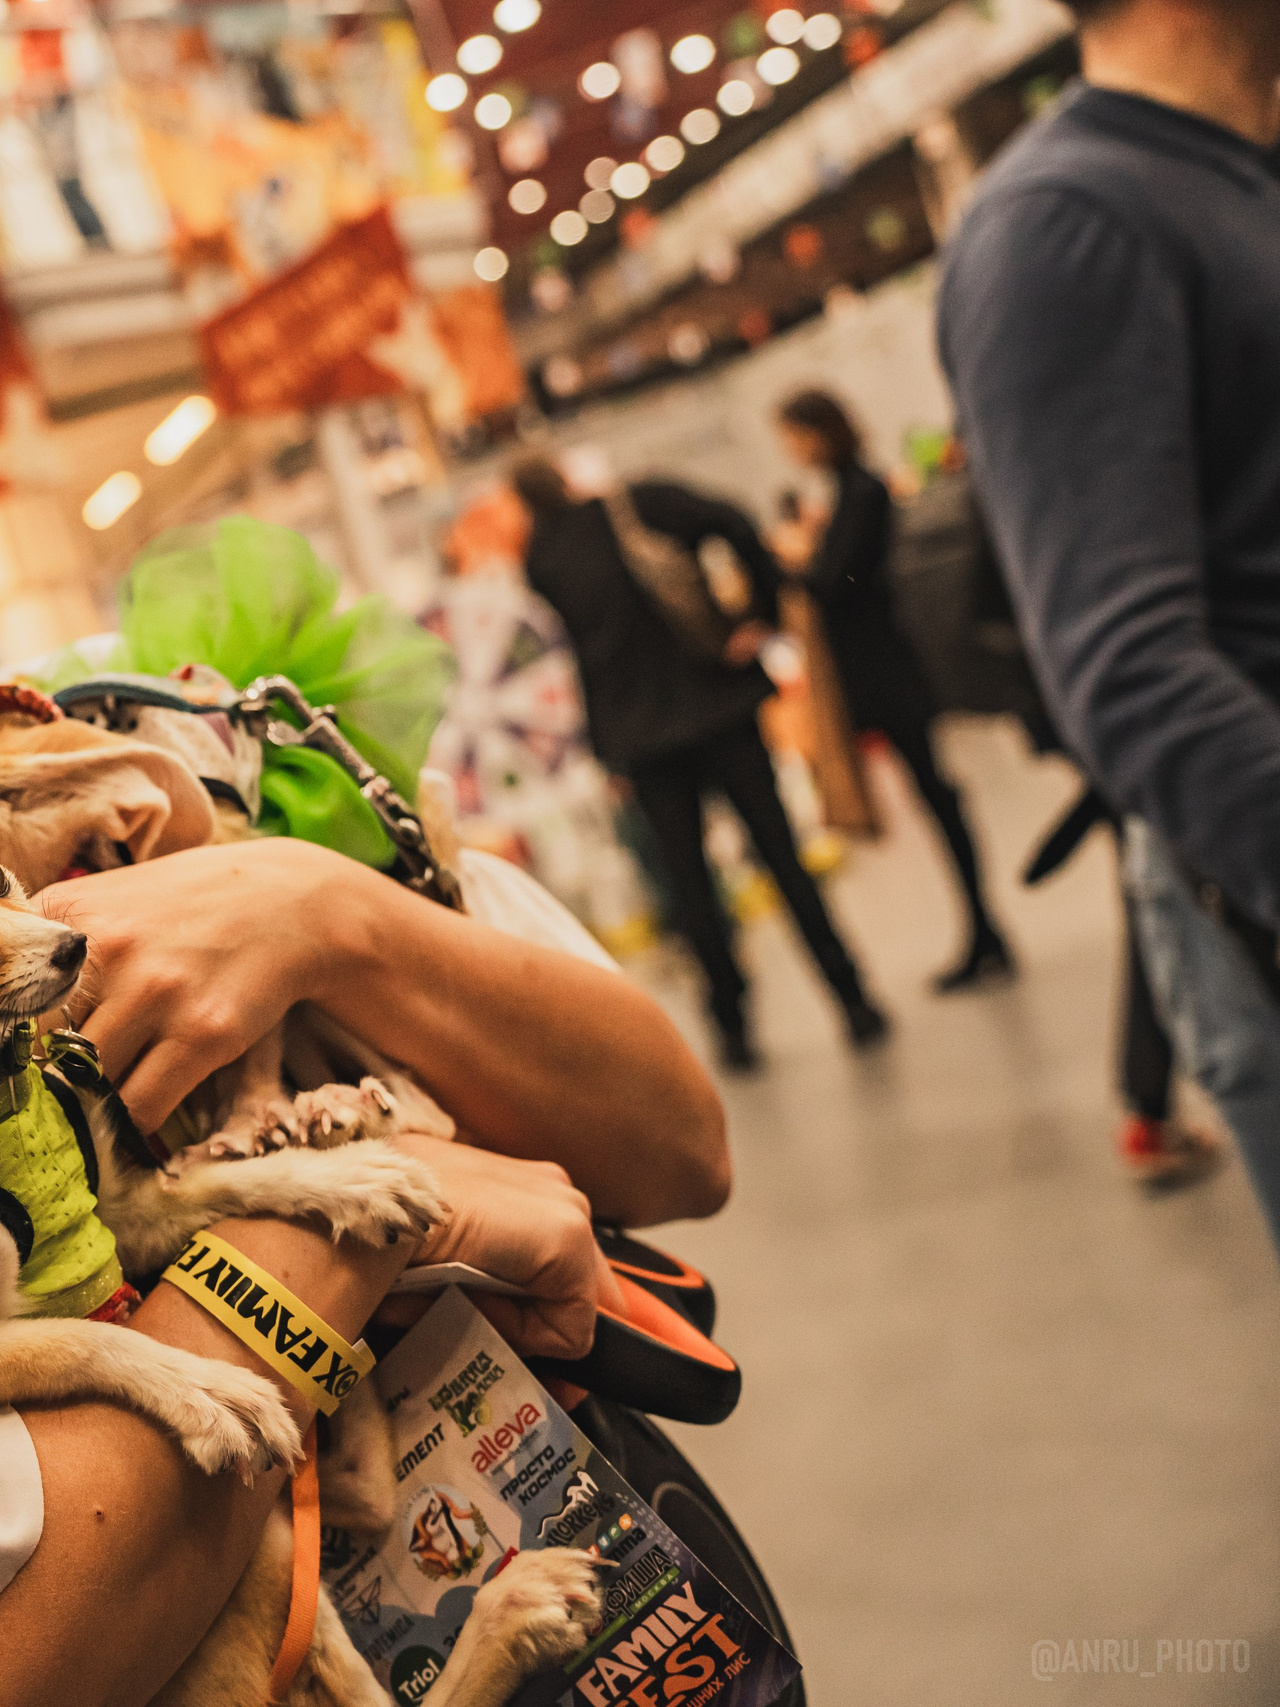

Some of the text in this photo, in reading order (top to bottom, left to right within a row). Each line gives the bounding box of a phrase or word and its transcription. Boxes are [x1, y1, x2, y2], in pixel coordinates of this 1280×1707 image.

[192, 1256, 329, 1373] FAMILY
[312, 1351, 359, 1398] OX
[471, 1402, 541, 1473] alleva
[500, 1445, 556, 1501] ПРОСТО
[519, 1447, 577, 1505] КОСМОС
[603, 1545, 672, 1626] АФИША
[634, 1573, 674, 1609] МОСКВА
[575, 1581, 708, 1707] FAMILY
[614, 1613, 740, 1707] EST
[398, 1658, 440, 1701] Triol
